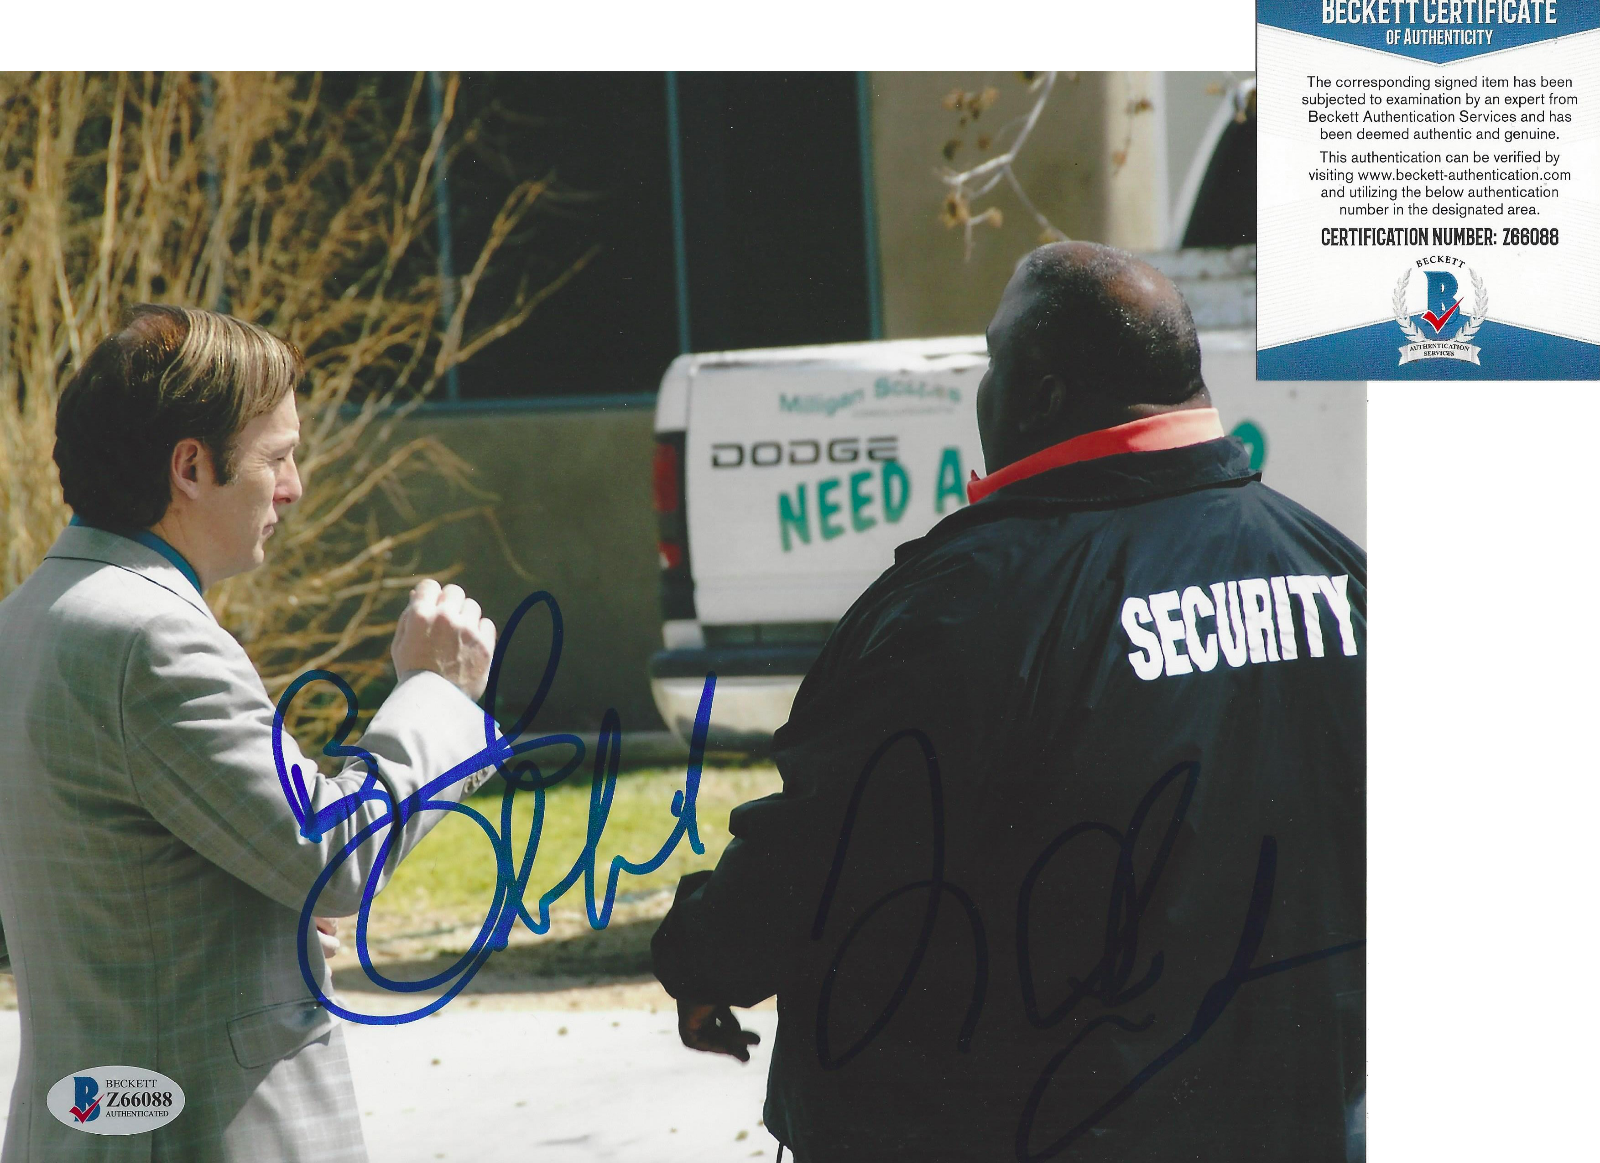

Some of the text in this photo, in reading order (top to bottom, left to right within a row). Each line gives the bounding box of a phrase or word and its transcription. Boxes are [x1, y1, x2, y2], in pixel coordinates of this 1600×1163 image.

[1322, 0, 1557, 24] BECKETT CERTIFICATE
[1386, 28, 1493, 45] OF AUTHENTICITY
[1306, 75, 1573, 90] The corresponding signed item has been
[1301, 92, 1578, 107] subjected to examination by an expert from
[1308, 109, 1572, 123] Beckett Authentication Services and has
[1320, 127, 1560, 142] been deemed authentic and genuine.
[1319, 150, 1560, 166] This authentication can be verified by
[1308, 168, 1571, 183] visiting www.beckett-authentication.com
[1320, 185, 1559, 200] and utilizing the below authentication
[1339, 202, 1540, 218] number in the designated area.
[1321, 228, 1559, 246] CERTIFICATION NUMBER: Z66088
[1415, 255, 1466, 268] BECKETT
[1409, 343, 1470, 352] AUTHENTICATION
[711, 435, 899, 469] DODGE
[777, 445, 969, 553] NEED A
[1121, 574, 1358, 681] SECURITY
[106, 1079, 157, 1088] BECKETT
[106, 1091, 173, 1108] Z66088
[105, 1110, 169, 1118] AUTHENTICATED
